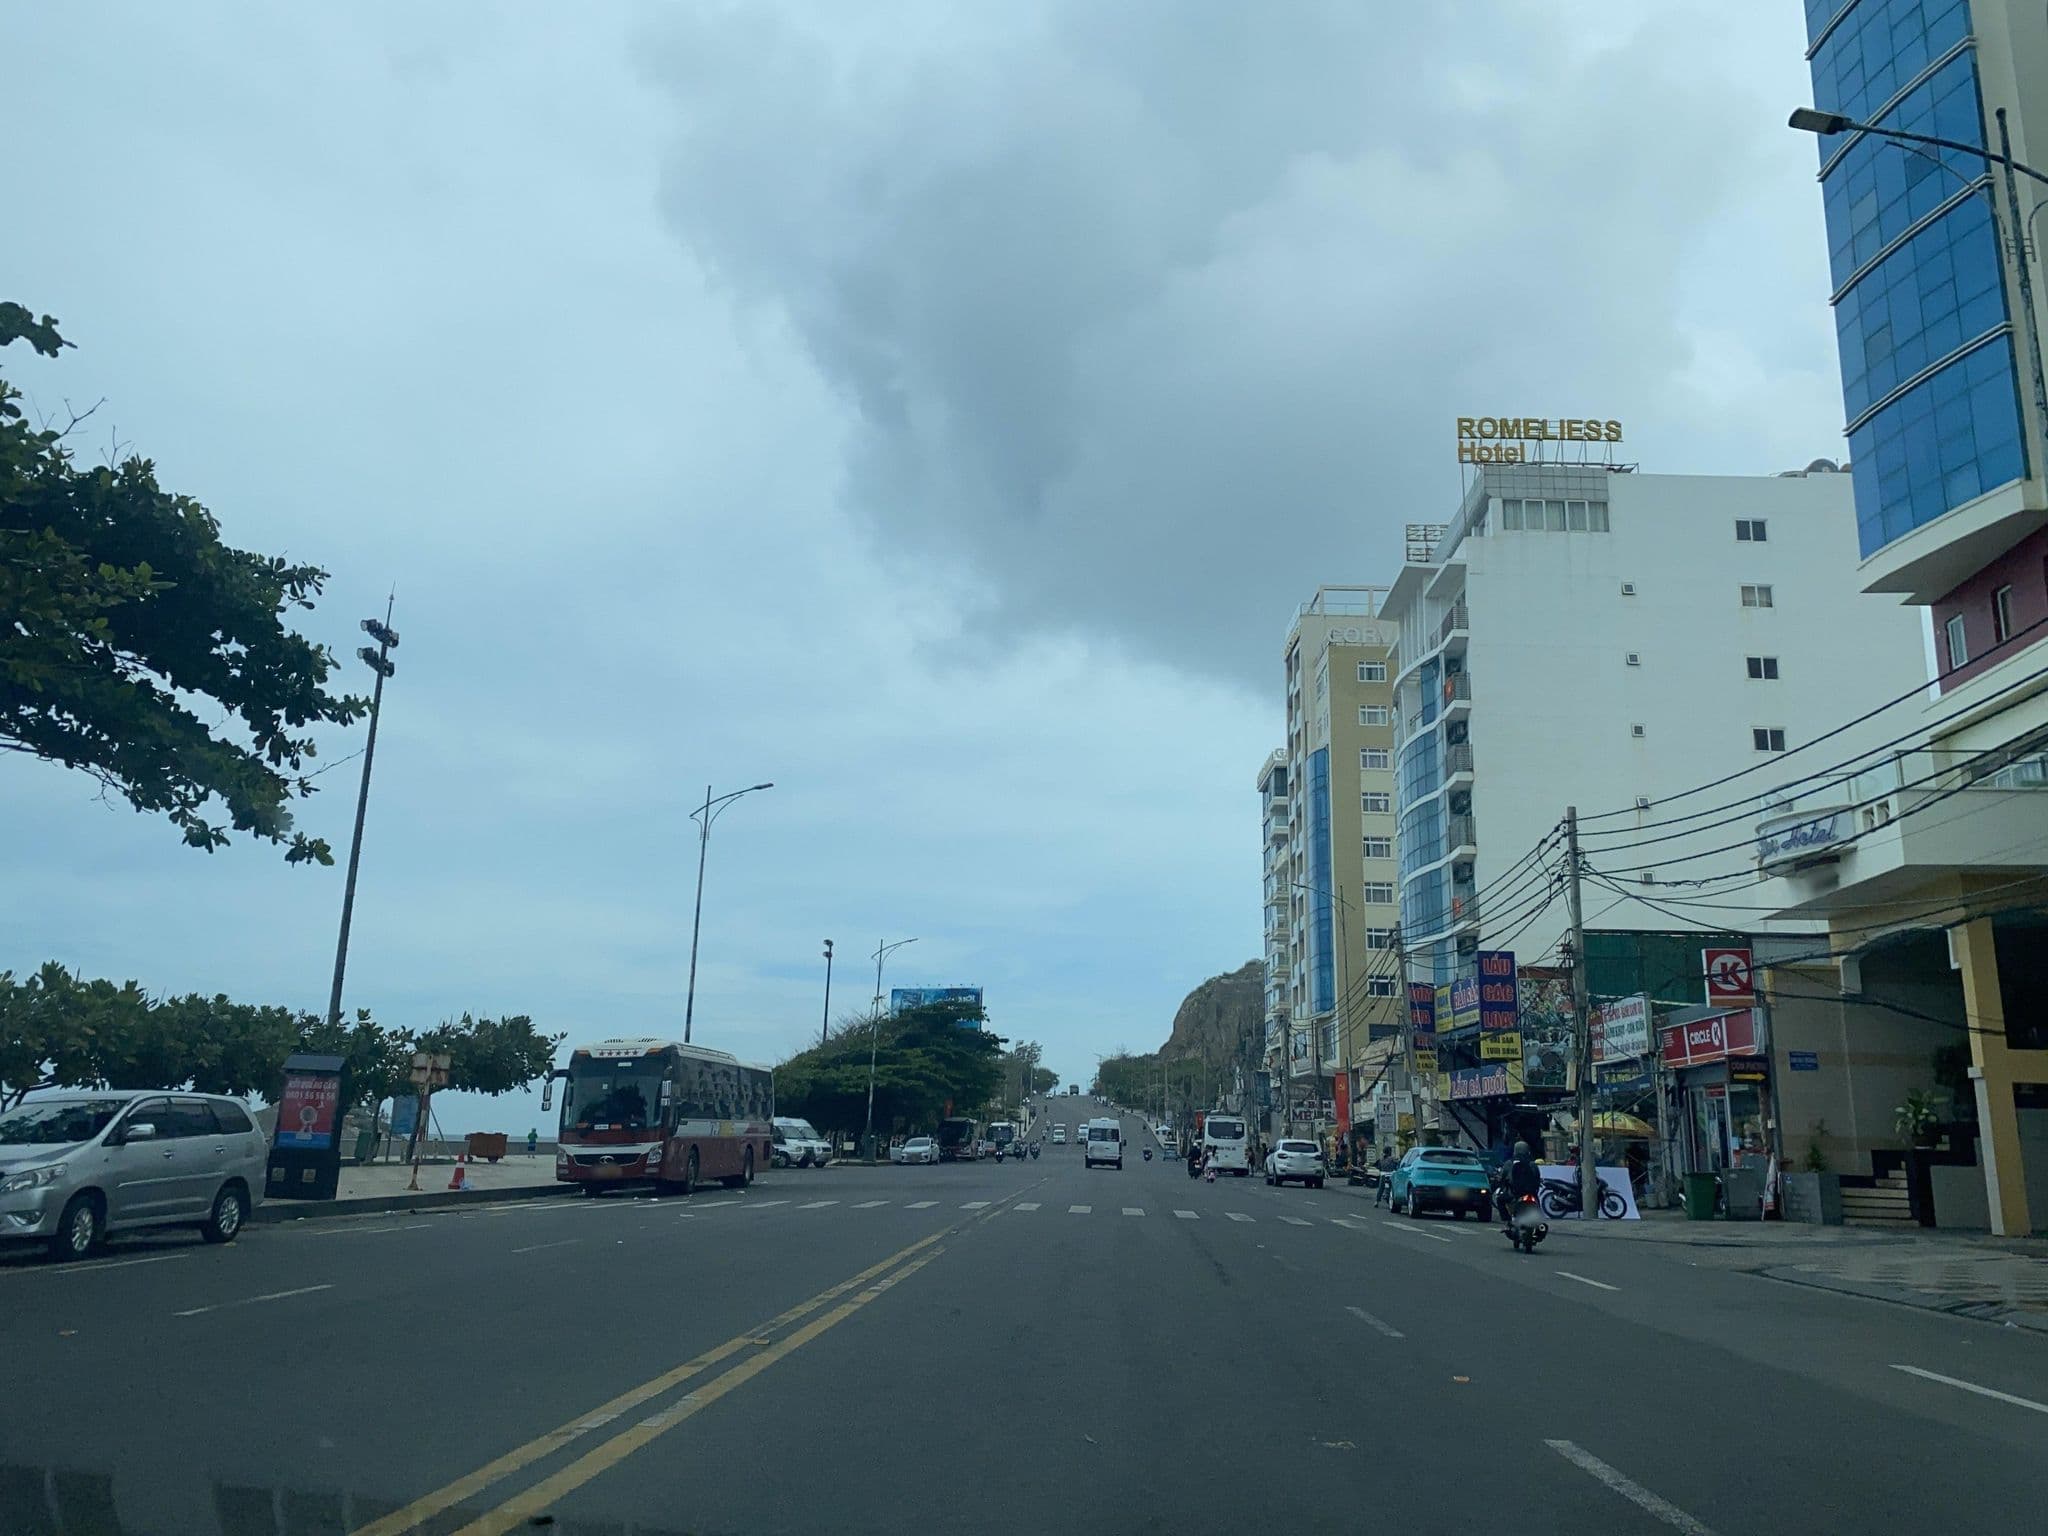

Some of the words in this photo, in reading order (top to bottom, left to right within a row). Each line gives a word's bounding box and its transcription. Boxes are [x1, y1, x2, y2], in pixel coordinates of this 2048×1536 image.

[1456, 416, 1622, 441] ROMELIESS
[1457, 441, 1526, 463] Hotel
[1689, 1029, 1711, 1046] CIRCLE
